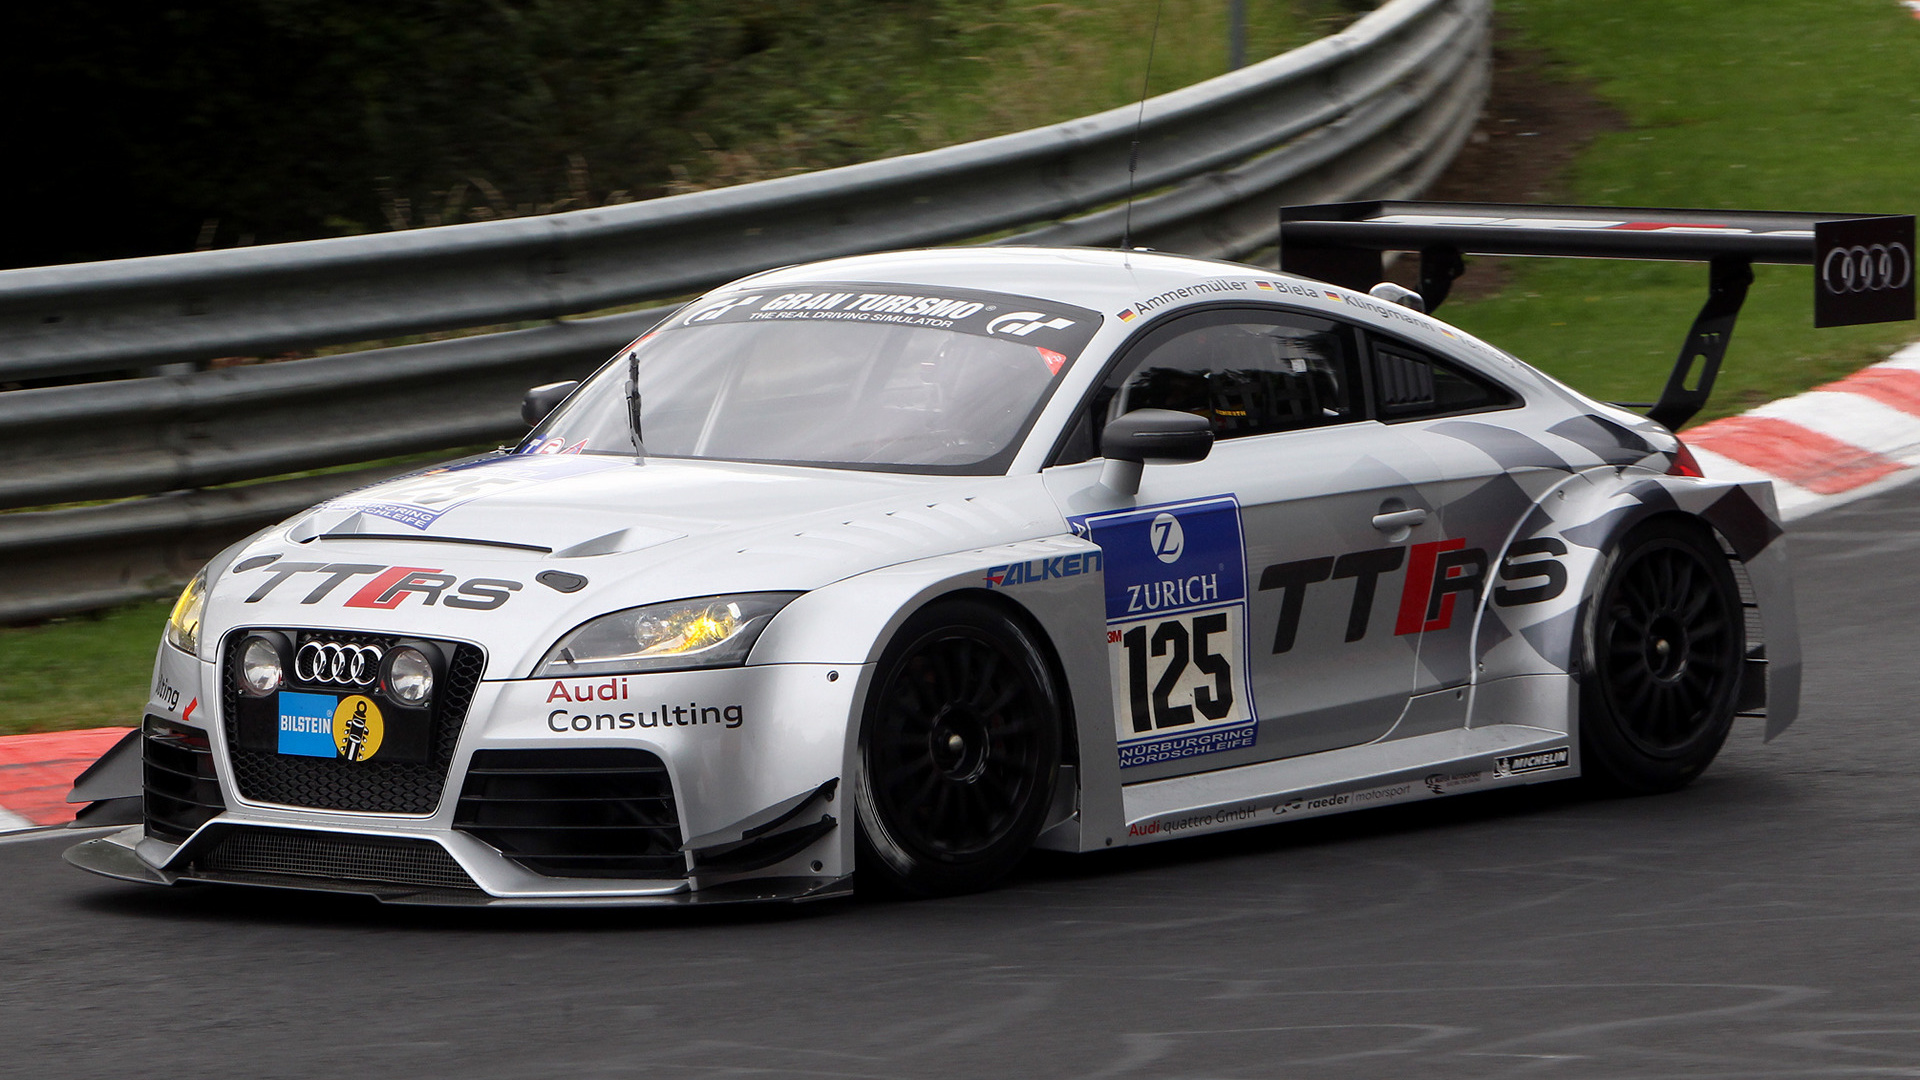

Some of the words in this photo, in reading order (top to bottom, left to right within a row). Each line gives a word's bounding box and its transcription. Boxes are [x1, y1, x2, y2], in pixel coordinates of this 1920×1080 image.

[749, 312, 778, 320] THE
[776, 311, 809, 320] REAL
[812, 311, 869, 321] DRIVING
[870, 313, 953, 328] SIMULATOR
[760, 292, 846, 312] GRAN
[843, 293, 985, 320] TURISMO
[1134, 279, 1247, 315] Ammermüller
[1273, 281, 1318, 299] Biela
[1341, 293, 1436, 332] Klingmann
[984, 551, 1102, 588] FALKEN
[1126, 572, 1219, 613] ZURICH
[1106, 629, 1122, 644] 3M
[1122, 612, 1234, 734] 125
[546, 676, 629, 704] Audi
[280, 714, 332, 735] BILSTEIN
[547, 702, 744, 733] Consulting
[1119, 737, 1252, 767] NORDSCHLEIFE
[1121, 727, 1254, 758] NÜRBURGRING
[1511, 751, 1568, 769] MICHELIN
[1307, 793, 1350, 810] raeder
[1355, 784, 1411, 801] motorsport
[1128, 819, 1160, 837] Audi
[1163, 814, 1212, 835] quattro
[1215, 804, 1257, 824] GmbH
